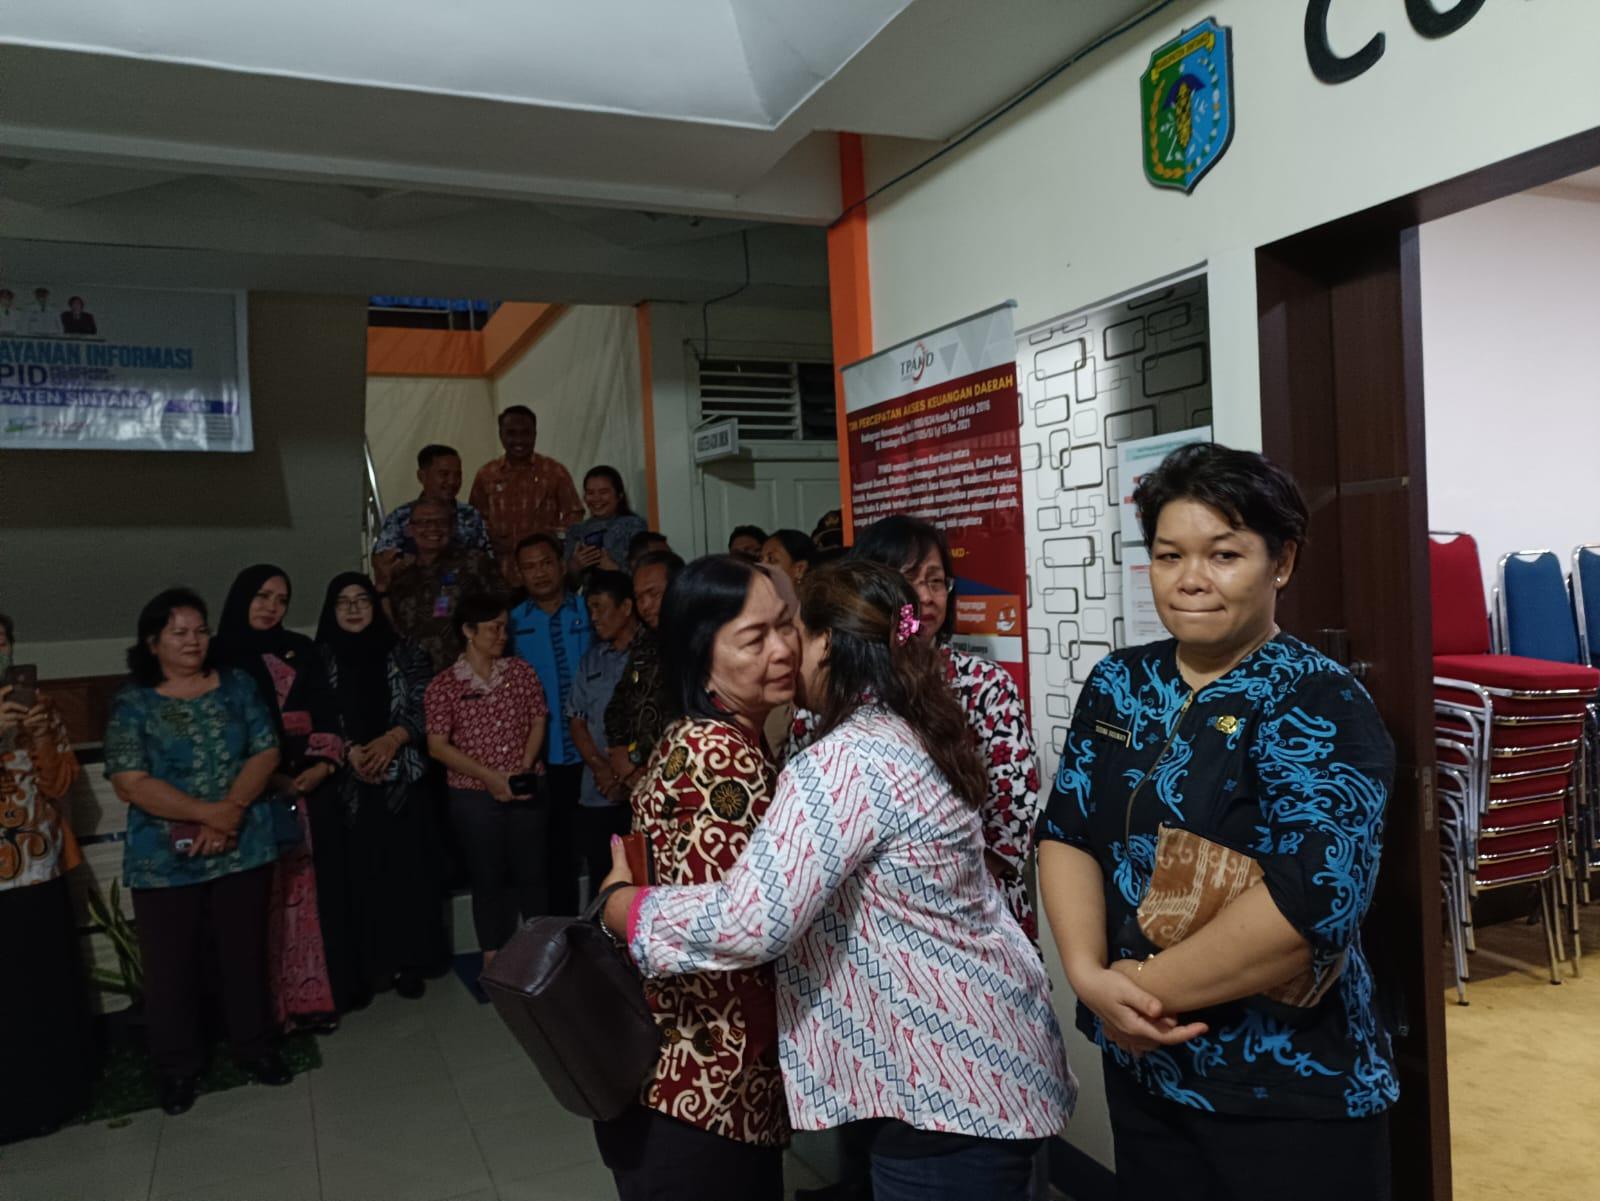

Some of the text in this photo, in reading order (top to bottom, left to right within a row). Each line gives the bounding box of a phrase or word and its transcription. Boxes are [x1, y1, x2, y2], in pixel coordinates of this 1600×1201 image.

[86, 343, 193, 369] INFORMASI
[928, 387, 972, 408] KEUANGAN
[975, 375, 1013, 396] DAERAH
